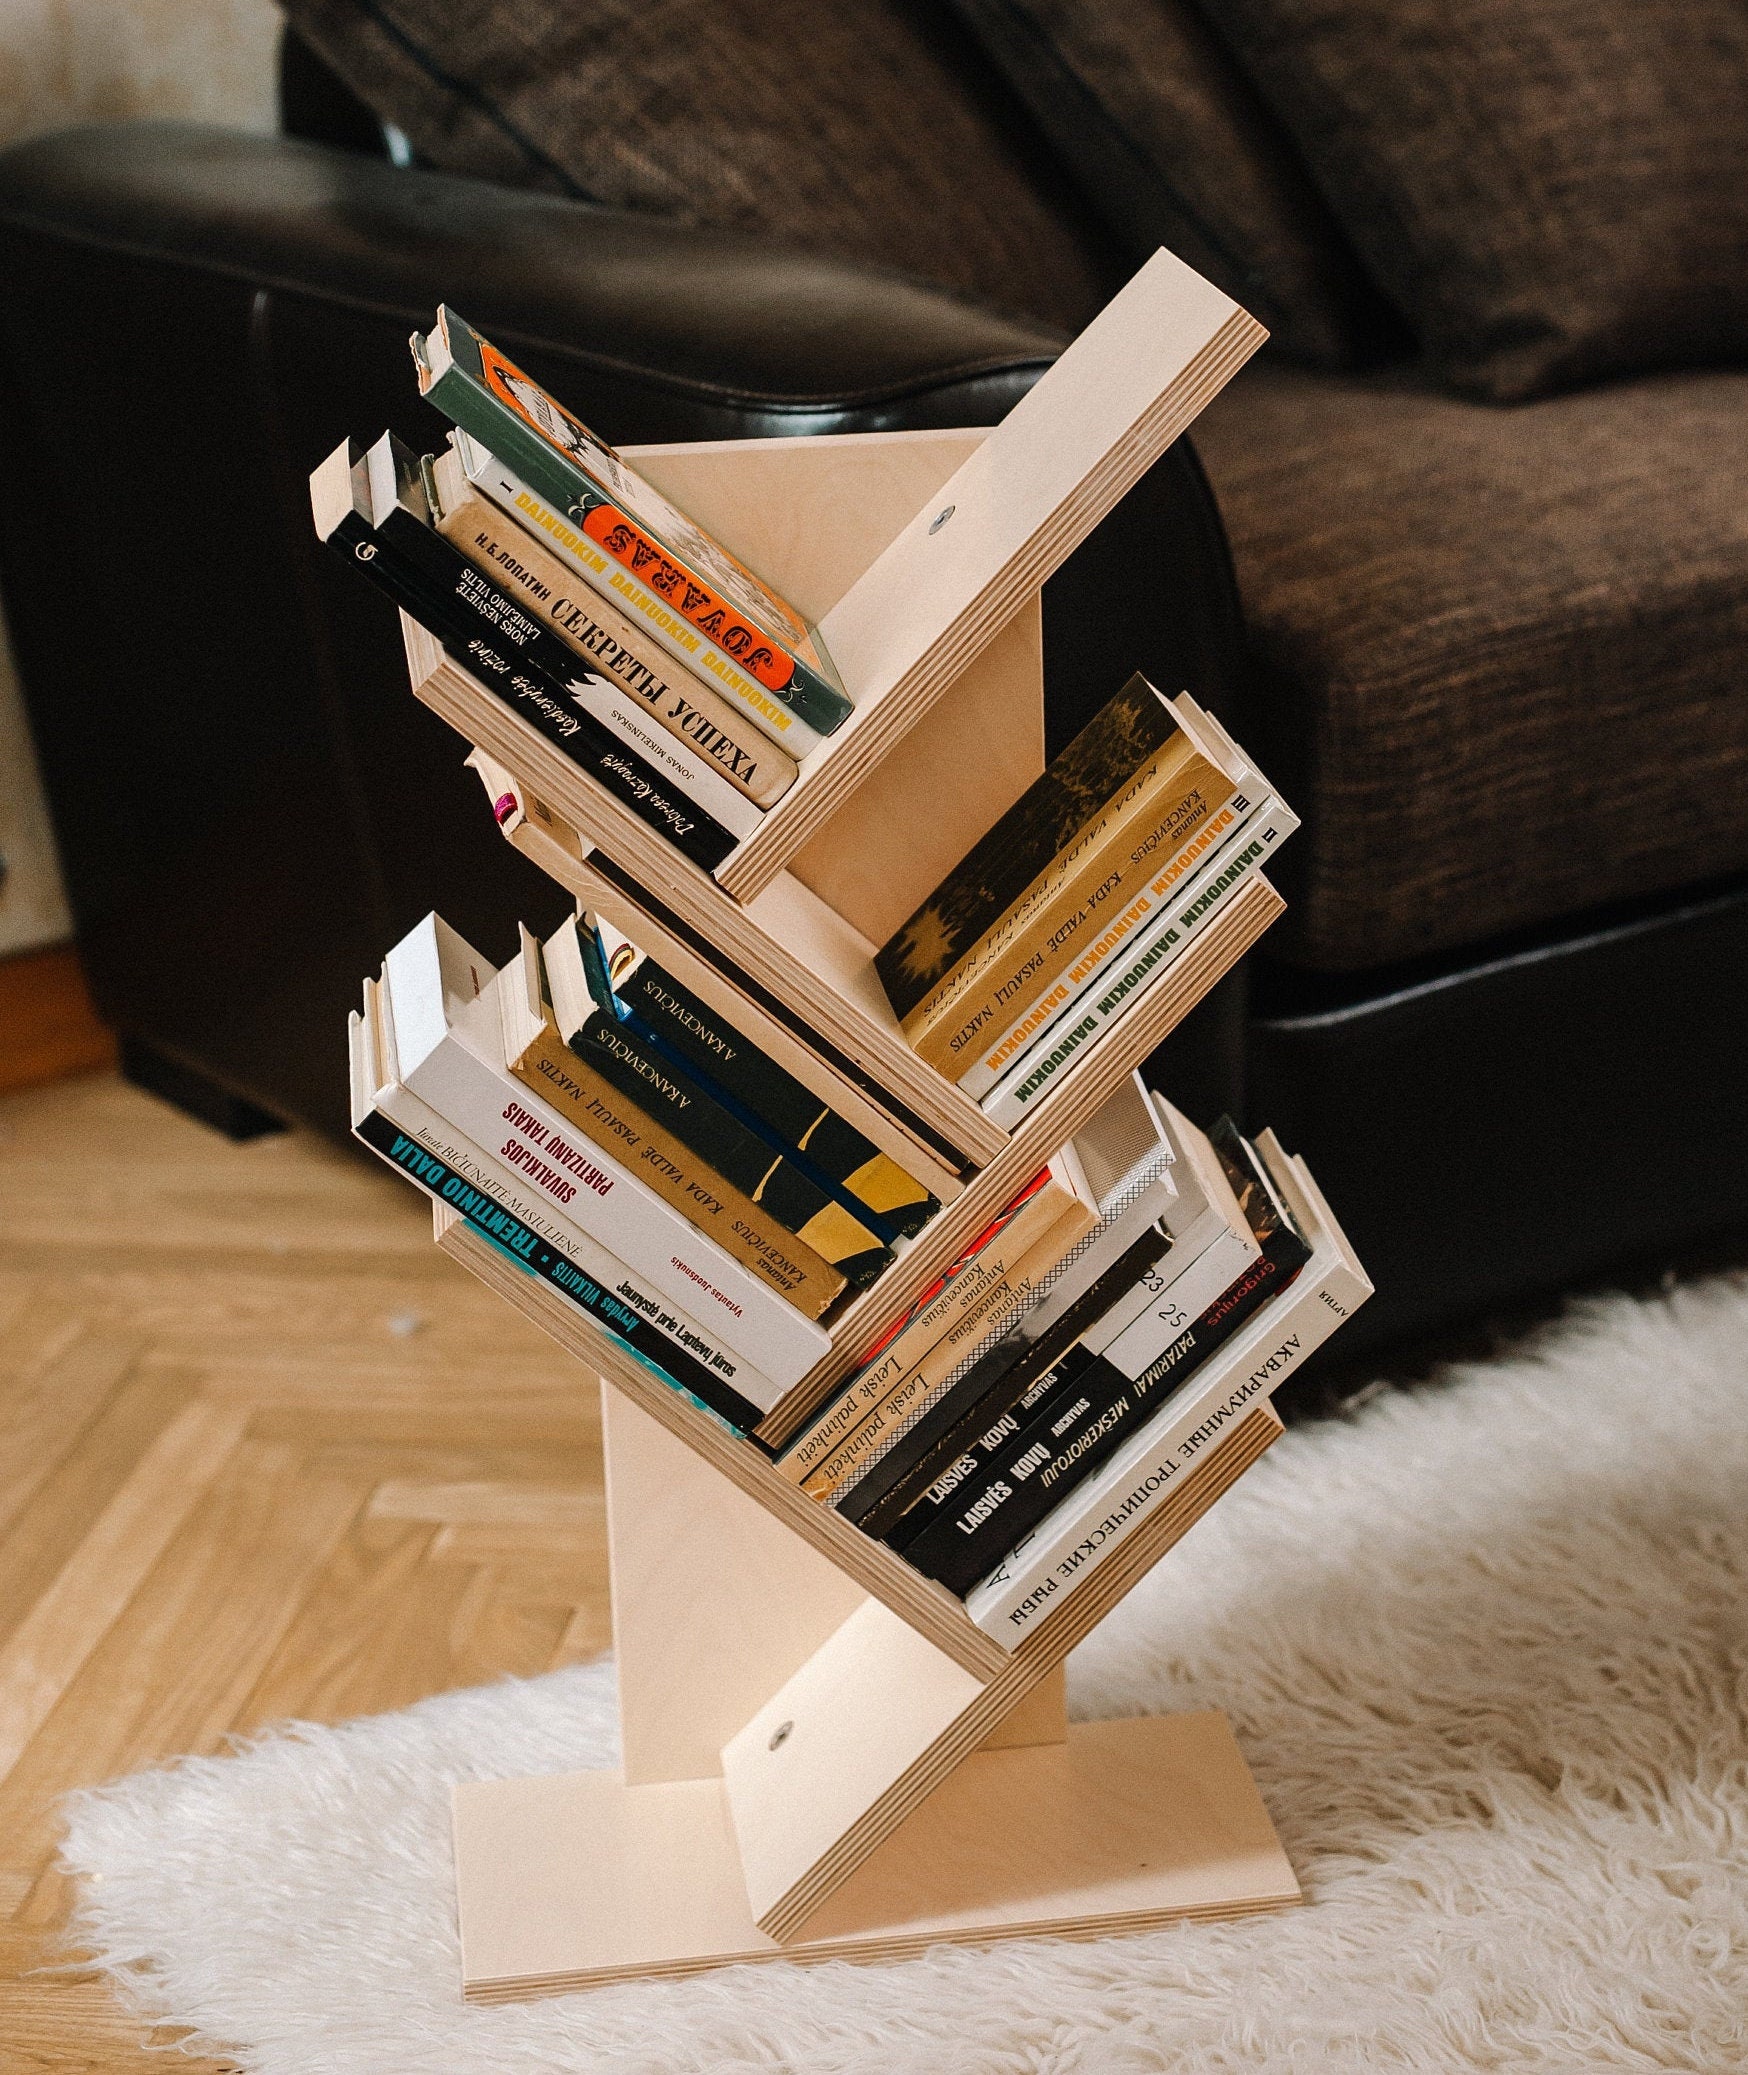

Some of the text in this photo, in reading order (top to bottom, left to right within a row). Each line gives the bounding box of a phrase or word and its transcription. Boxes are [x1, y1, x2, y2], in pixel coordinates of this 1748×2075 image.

[455, 582, 529, 646] NORS NEŠVIETĖ
[460, 568, 542, 640] LAIMĖJIMO VILTIS
[514, 492, 609, 576] DAINUOKIM
[608, 571, 702, 655] DAINUOKIM
[701, 650, 793, 732] DAINUOKIM
[603, 524, 774, 673] JOVARAS
[551, 598, 758, 786] СЕКРЕТЫ УСПЕХА
[611, 709, 695, 781] JONAS MIKELINSKAS
[1114, 764, 1158, 812] KADA
[1171, 800, 1208, 840] Antanas
[1130, 788, 1202, 865] KANCEVIČIUS
[950, 871, 1122, 1053] KADA VALDĖ PASAULĮ NAKTIS
[985, 794, 1251, 1072] III DAINUOKIM DAINUOKIM DAINUOKIM
[1014, 826, 1278, 1103] II DAINUOKIM DAINUOKIM DAINUOKIM
[923, 954, 977, 1018] NAKTIS
[501, 1138, 577, 1204] SUVALKIJOS
[502, 1102, 615, 1197] PARTIZANŲ TAKAIS
[536, 1058, 725, 1216] KADA VALDĖ PASAULĮ NAKTIS
[389, 1135, 640, 1333] Arvydas VILKAITIS TREMTINIO DALIA
[731, 1220, 808, 1284] KANCEVIČIUS
[670, 1256, 744, 1319] Vytautas Juodsnukis
[756, 1258, 797, 1291] Antanas
[921, 1263, 986, 1328] Kancevičius
[959, 1259, 1006, 1309] Antanas
[987, 1276, 1032, 1326] Antanas
[1140, 1268, 1165, 1292] 23
[616, 1280, 660, 1318] Jaunystė
[656, 1311, 679, 1332] prie
[675, 1324, 714, 1363] Laptevų
[948, 1279, 1013, 1345] Kancevičius
[1158, 1303, 1188, 1328] 25
[1132, 1330, 1197, 1398] PATARIMAI
[1177, 1333, 1302, 1459] АКВАРИУМНЫЕ
[796, 1355, 904, 1468] Leisk palinkėti
[823, 1372, 931, 1485] Leisk palinkėti
[978, 1414, 1021, 1452] KOVŲ
[1020, 1372, 1058, 1410] ARCHYVAS
[1040, 1396, 1130, 1488] MEŠKERIOTOJUI
[956, 1480, 1014, 1533] LAISVĖS
[1009, 1442, 1052, 1482] KOVŲ
[1050, 1397, 1092, 1438] ARCHYVAS
[1056, 1458, 1181, 1578] ТРОПИЧЕСКИЕ
[1008, 1577, 1060, 1626] РЫБЫ
